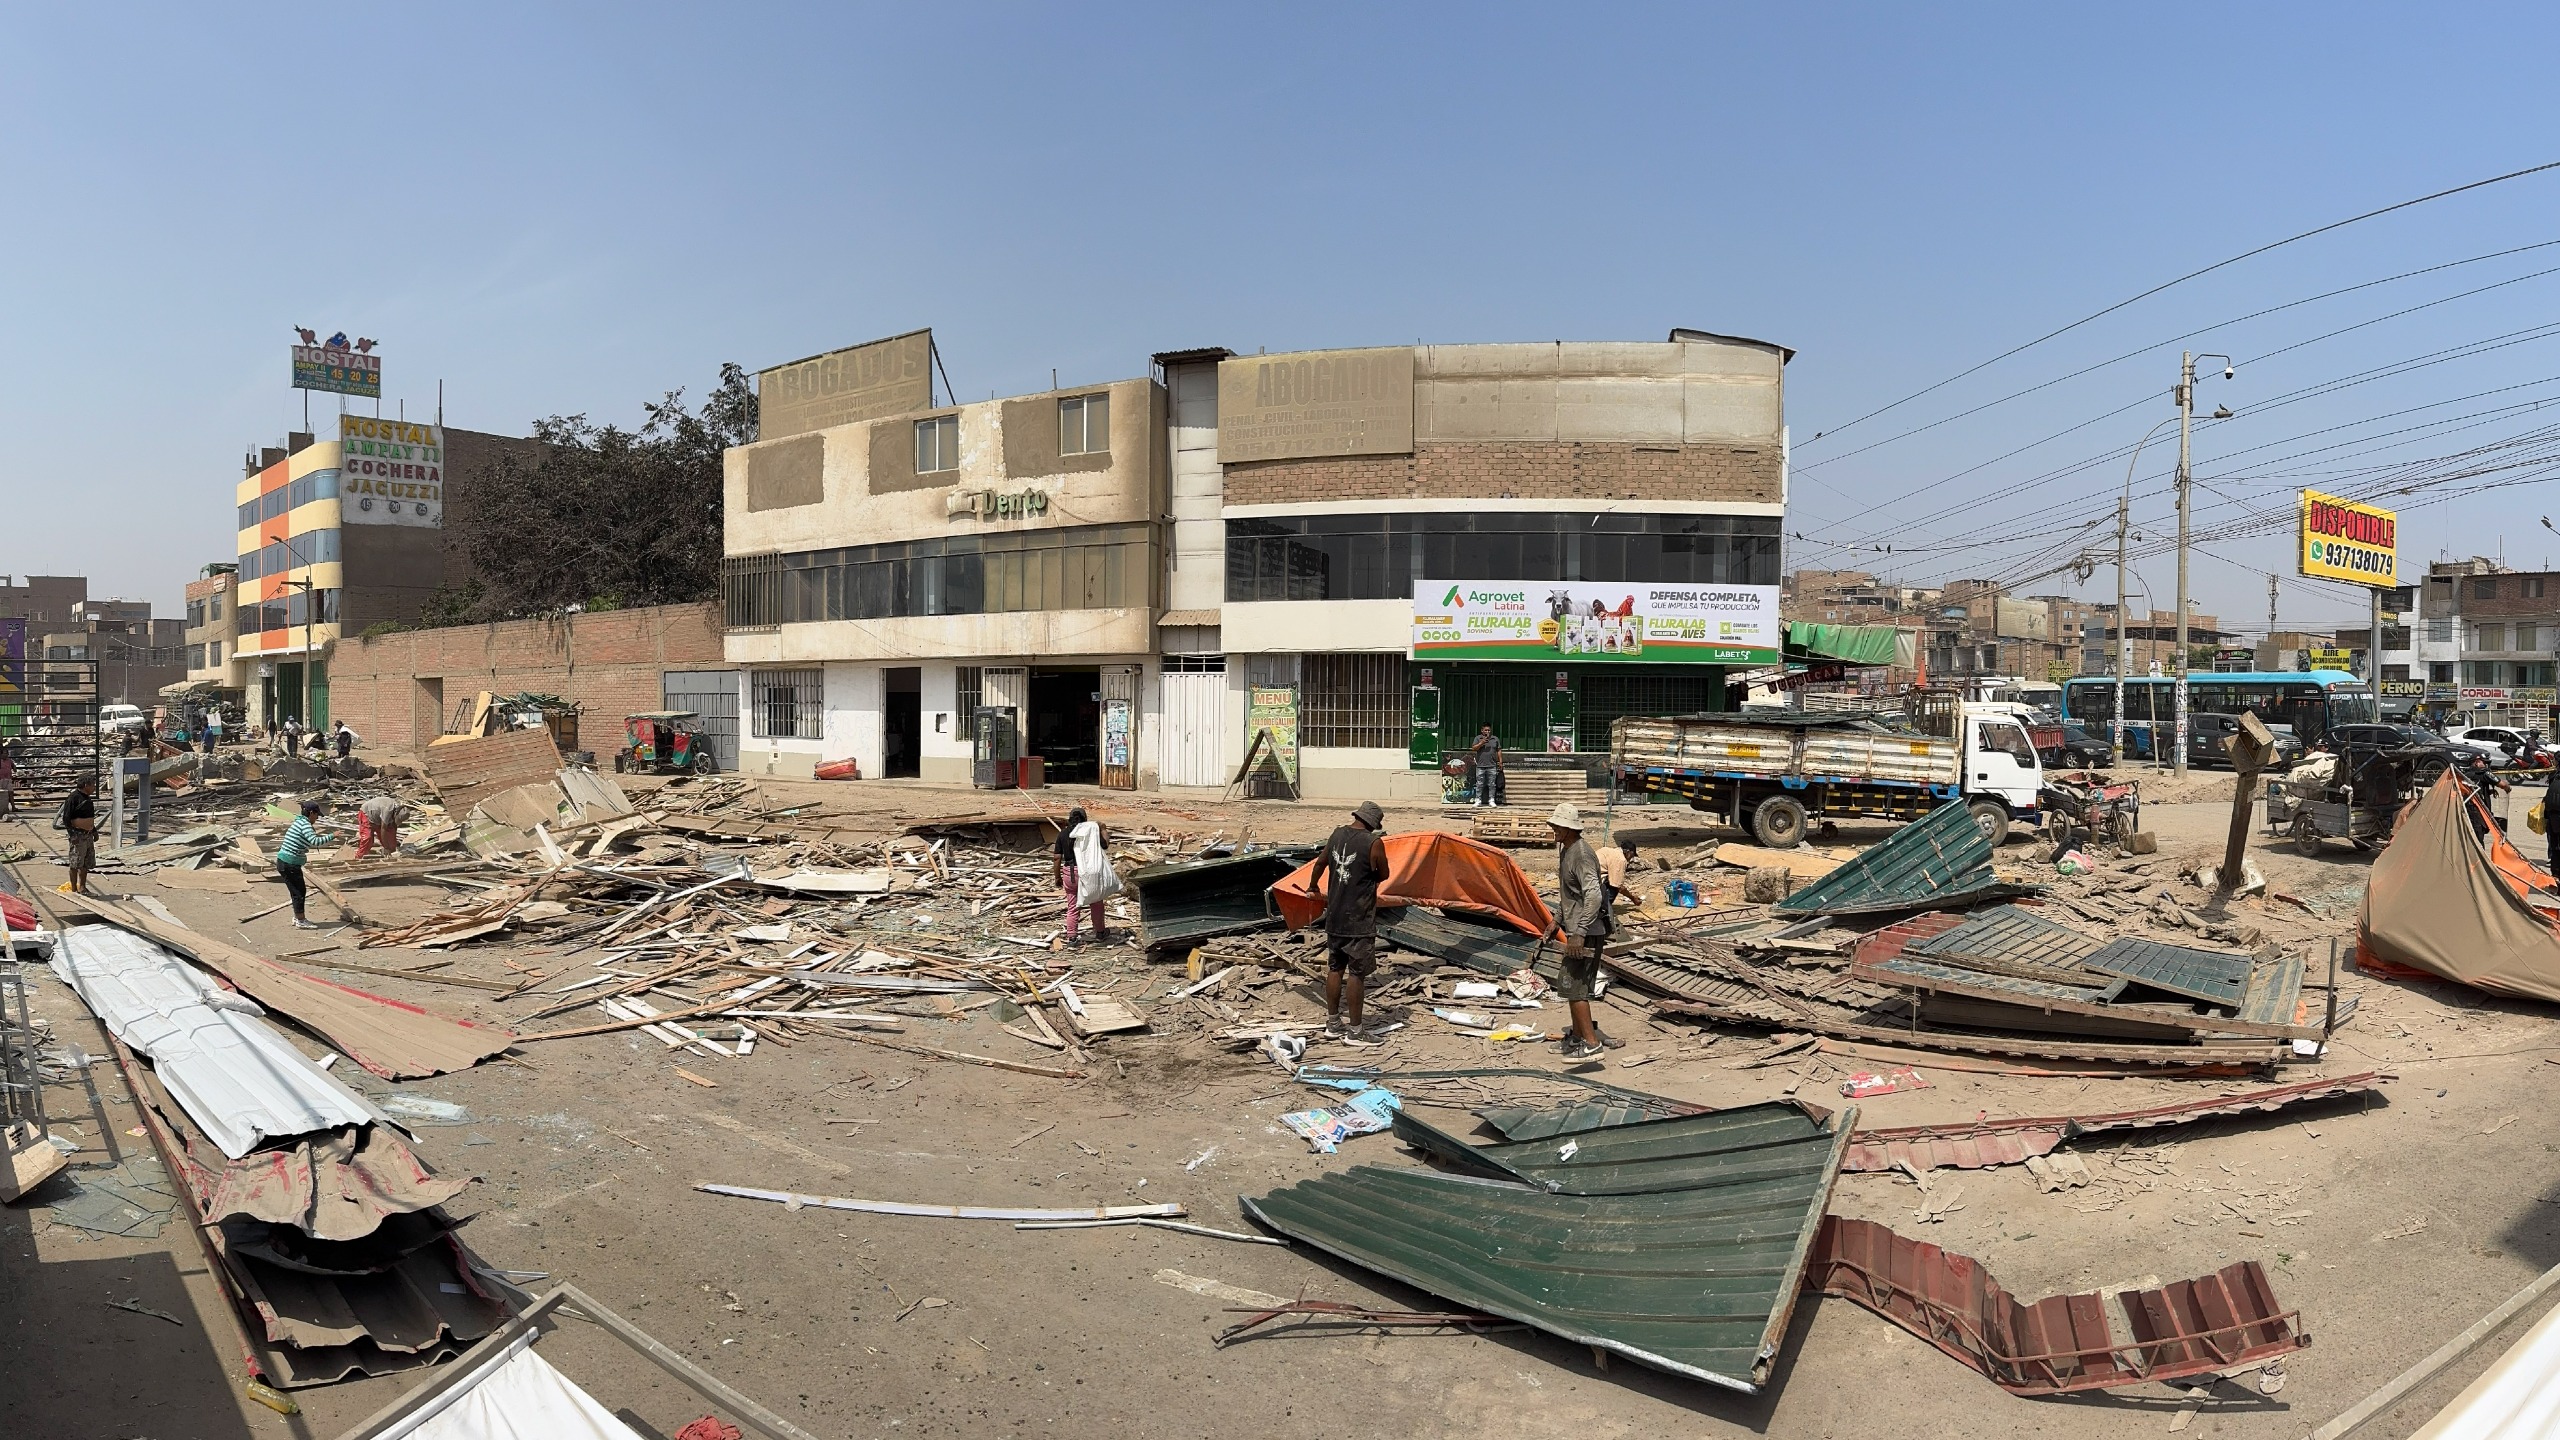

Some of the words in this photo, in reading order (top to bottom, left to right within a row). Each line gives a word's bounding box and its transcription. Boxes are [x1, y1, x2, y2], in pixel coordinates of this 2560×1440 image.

[295, 347, 379, 371] HOSTAL
[296, 362, 319, 371] AMPAY
[350, 371, 361, 381] 20
[368, 373, 378, 383] 25
[764, 339, 925, 404] ABOGADOS
[295, 380, 342, 391] COCHERA
[345, 386, 380, 395] JACUZZI
[1256, 355, 1405, 408] ABOGADOS
[1223, 415, 1256, 427] PENAL
[1264, 412, 1293, 424] CIVIL
[1303, 408, 1352, 420] LABORAL
[344, 416, 437, 446] HOSTAL
[1226, 423, 1324, 440] CONSTITUCIONAL
[345, 439, 413, 460] AMPAY
[422, 448, 440, 462] II
[1235, 441, 1276, 457] 954
[1281, 438, 1317, 453] 712
[348, 459, 440, 481] COCHERA
[347, 479, 439, 500] JACUZZI
[390, 502, 400, 511] 20
[981, 488, 1047, 514] Dento
[417, 505, 427, 514] 25
[2310, 499, 2394, 549] DISPONIBLE
[2325, 543, 2393, 576] 937138079
[1468, 590, 1525, 604] Agrovet
[1650, 591, 1698, 601] DEFENSA
[1700, 592, 1761, 604] COMPLETA,
[1494, 602, 1525, 611] Latina
[1668, 602, 1698, 610] IMPULSA
[1710, 602, 1760, 611] PRODUCCIÓN
[1467, 617, 1532, 628] FLURALAB
[1649, 618, 1706, 629] FLURALAB
[1681, 630, 1706, 639] AVES
[1714, 650, 1740, 658] LABET
[2322, 649, 2339, 657] AIRE
[1767, 665, 1841, 694] NUTRICAN
[1254, 690, 1292, 705] MENÚ
